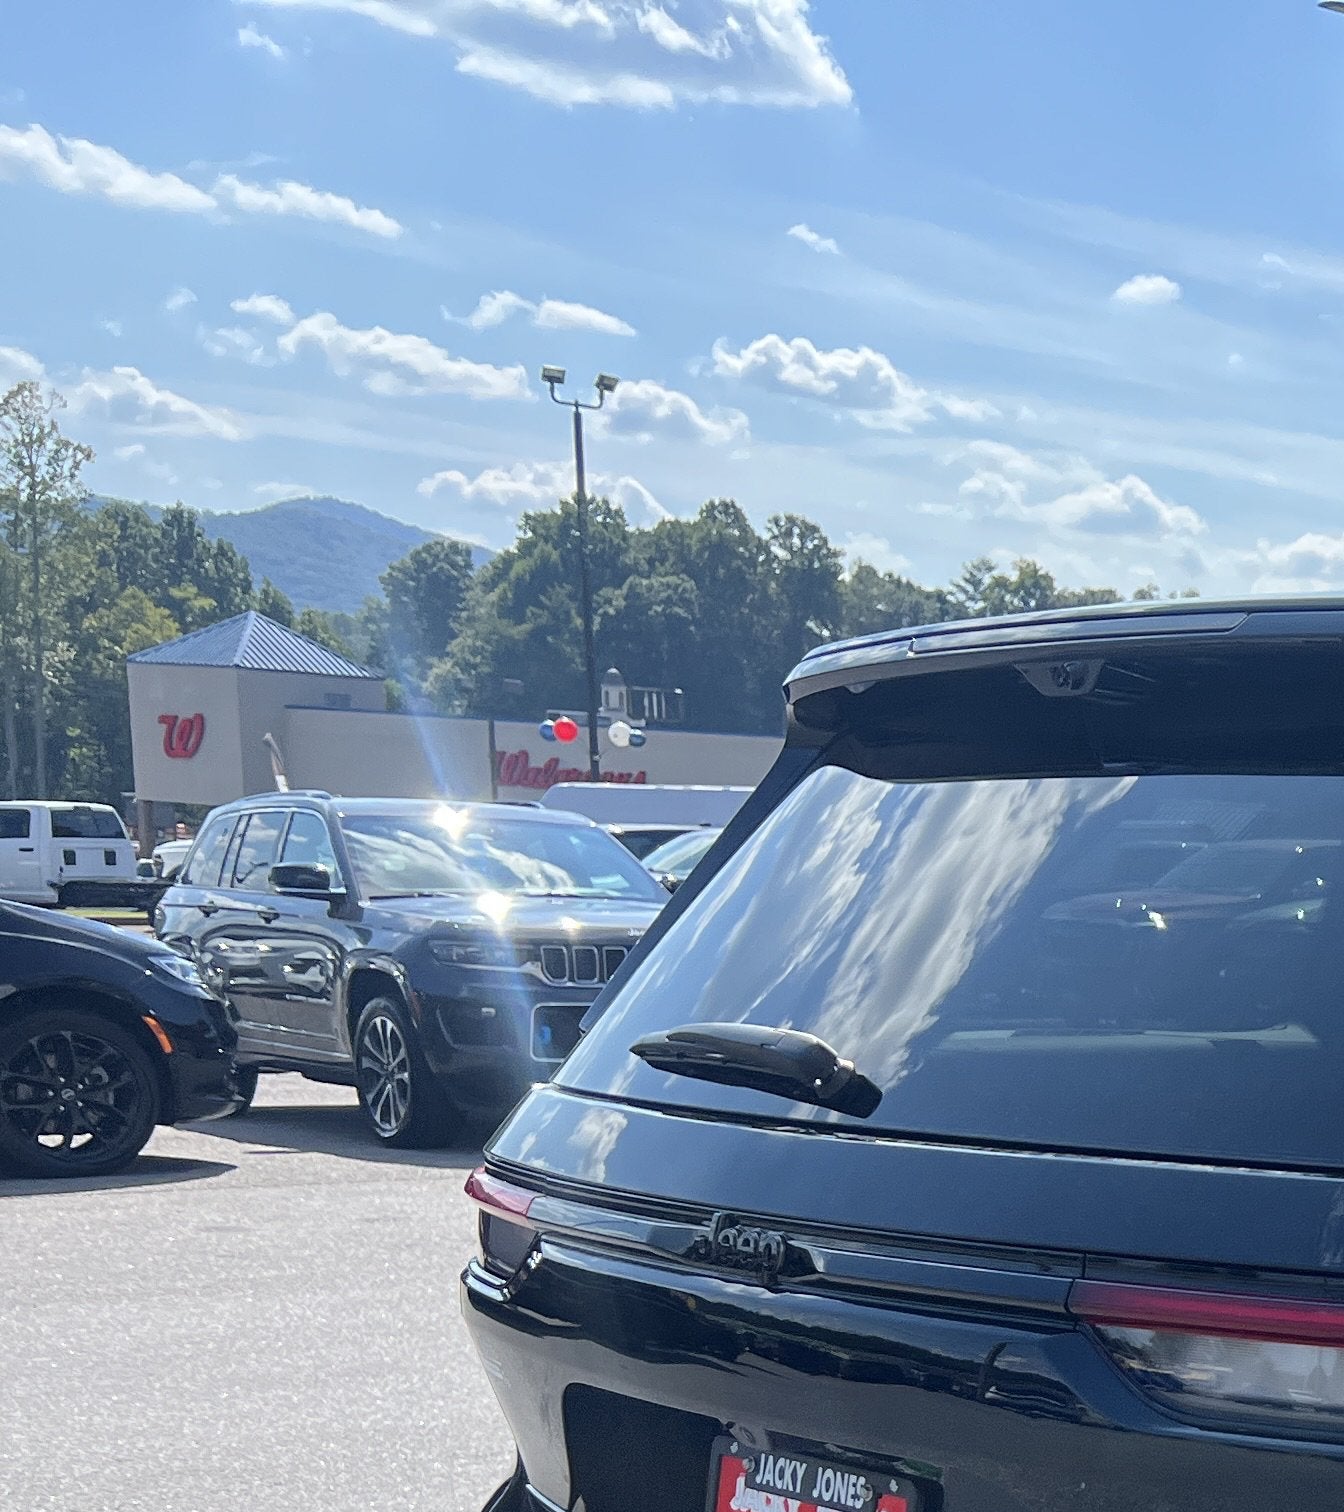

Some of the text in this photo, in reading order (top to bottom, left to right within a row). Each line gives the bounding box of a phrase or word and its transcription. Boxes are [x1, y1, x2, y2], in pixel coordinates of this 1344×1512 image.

[158, 713, 205, 758] W
[496, 750, 647, 789] Walgrens
[755, 1453, 867, 1510] JACKY JONES
